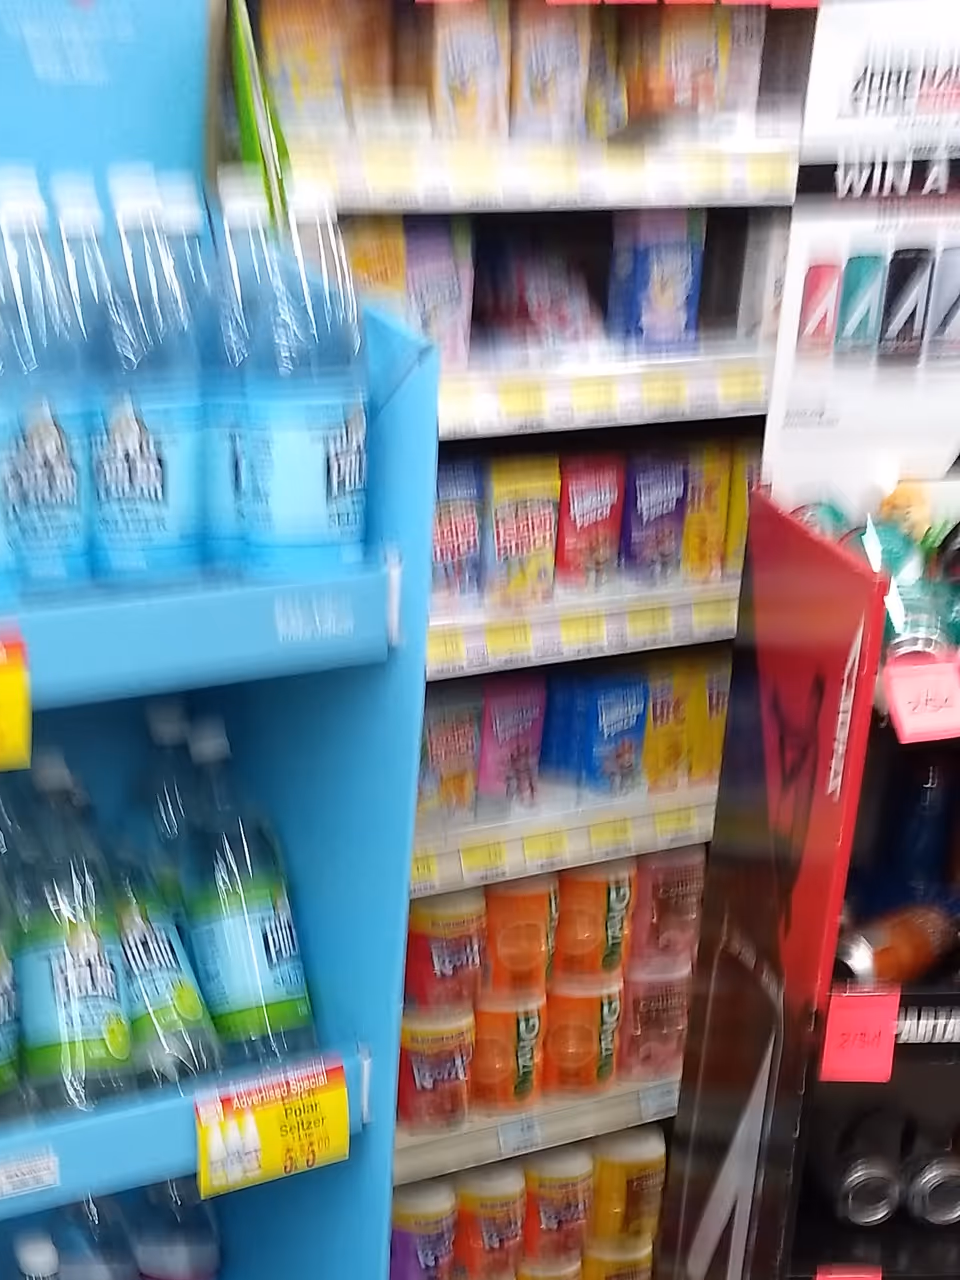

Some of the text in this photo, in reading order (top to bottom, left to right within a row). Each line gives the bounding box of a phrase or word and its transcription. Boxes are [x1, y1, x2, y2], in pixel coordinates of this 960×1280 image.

[834, 158, 913, 198] WIN
[517, 1010, 541, 1075] TANG
[600, 990, 622, 1058] TANG
[233, 1074, 328, 1110] Advertised Special
[283, 1100, 321, 1121] Polar
[279, 1116, 327, 1138] Seltzer
